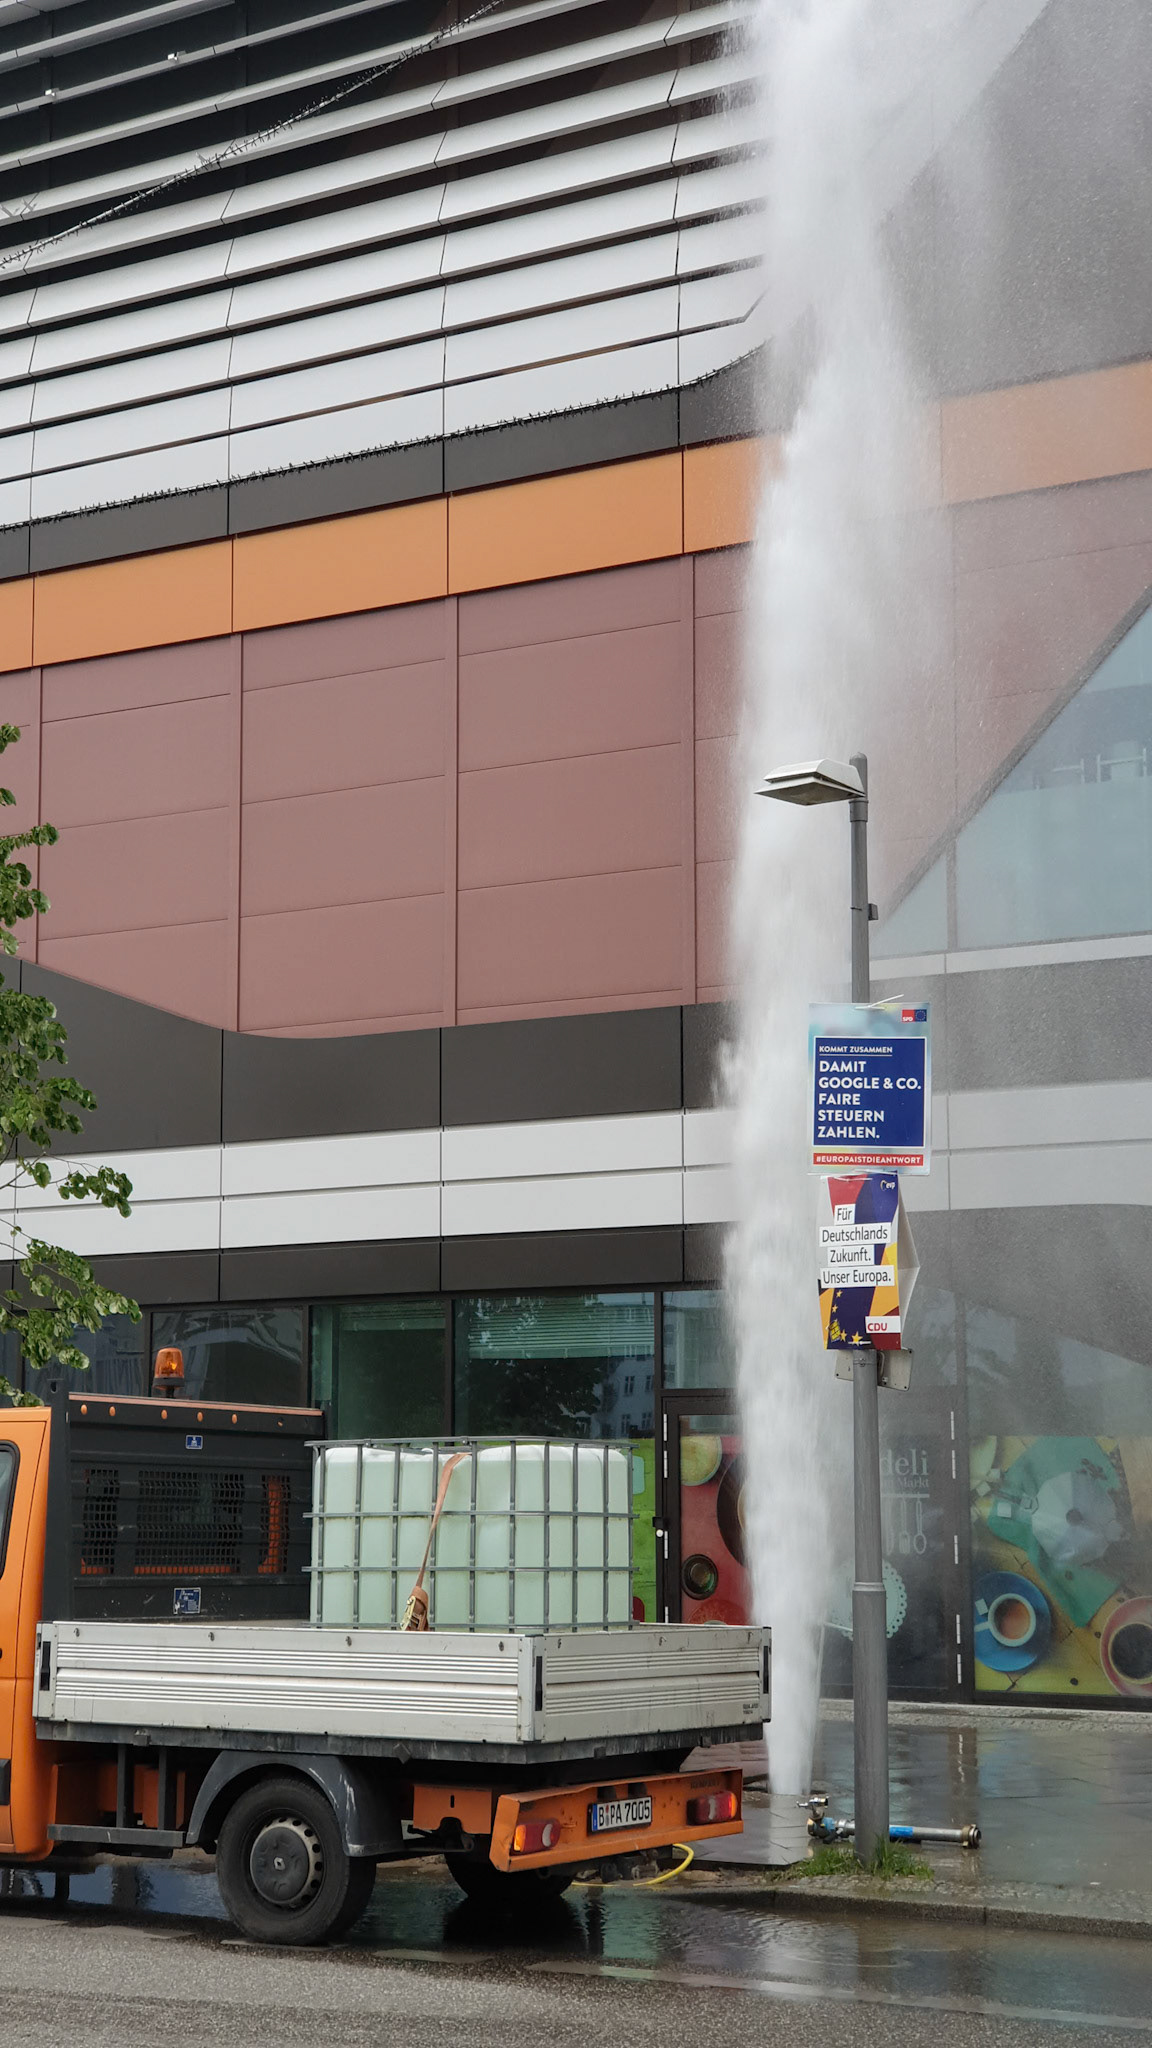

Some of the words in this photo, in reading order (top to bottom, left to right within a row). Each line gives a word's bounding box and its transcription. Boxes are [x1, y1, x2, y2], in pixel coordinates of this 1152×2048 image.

[819, 1061, 866, 1072] DAMIT
[818, 1077, 880, 1089] GOOGLE
[883, 1078, 893, 1089] &
[896, 1078, 921, 1090] CO.
[818, 1094, 861, 1105] FAIRE
[818, 1110, 885, 1122] STEUERN
[817, 1127, 880, 1138] ZAHLEN.
[816, 1156, 921, 1164] #EUROPAISTDIEANTWORT
[837, 1208, 852, 1221] Für
[822, 1225, 888, 1243] Deutschlands
[830, 1247, 871, 1262] Zukunft.
[823, 1270, 850, 1284] Unser
[853, 1268, 891, 1286] Europa.
[867, 1322, 888, 1332] CDU
[598, 1807, 604, 1826] B
[610, 1804, 622, 1824] PA
[624, 1800, 650, 1822] 7005
